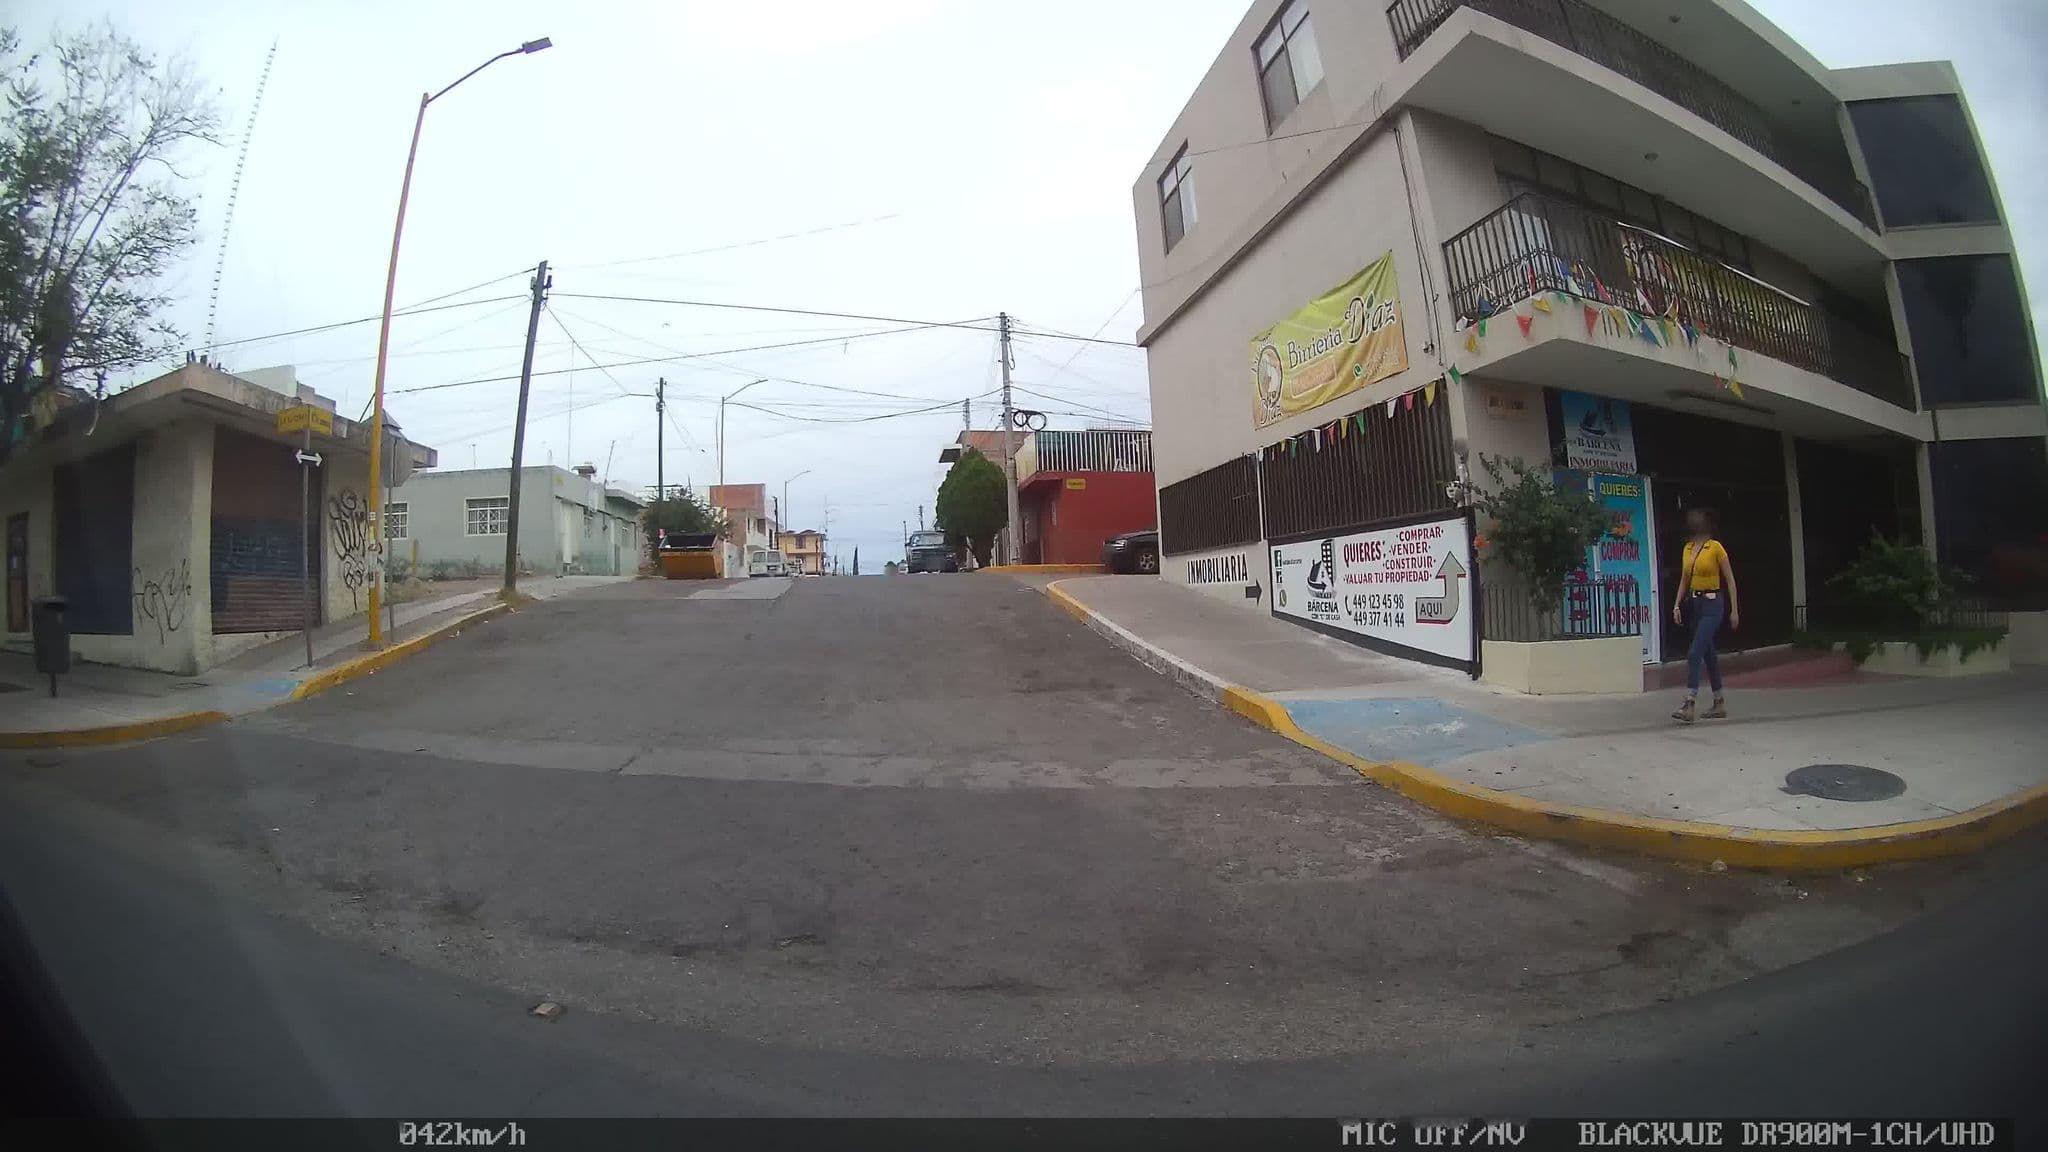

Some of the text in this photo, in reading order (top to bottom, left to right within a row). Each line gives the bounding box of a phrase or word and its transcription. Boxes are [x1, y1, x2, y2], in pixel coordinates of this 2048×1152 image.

[1287, 327, 1343, 369] Birrieria
[1400, 526, 1441, 541] COMPRAR
[1391, 541, 1428, 556] VENDER
[1187, 553, 1248, 585] INMOBILIARIA
[1385, 556, 1432, 570] CONSTRUIR
[1346, 570, 1429, 585] VALUAR TU PROPIEDAD
[1353, 594, 1404, 610] 449 123 45 98
[1354, 611, 1405, 628] 449 377 41 44
